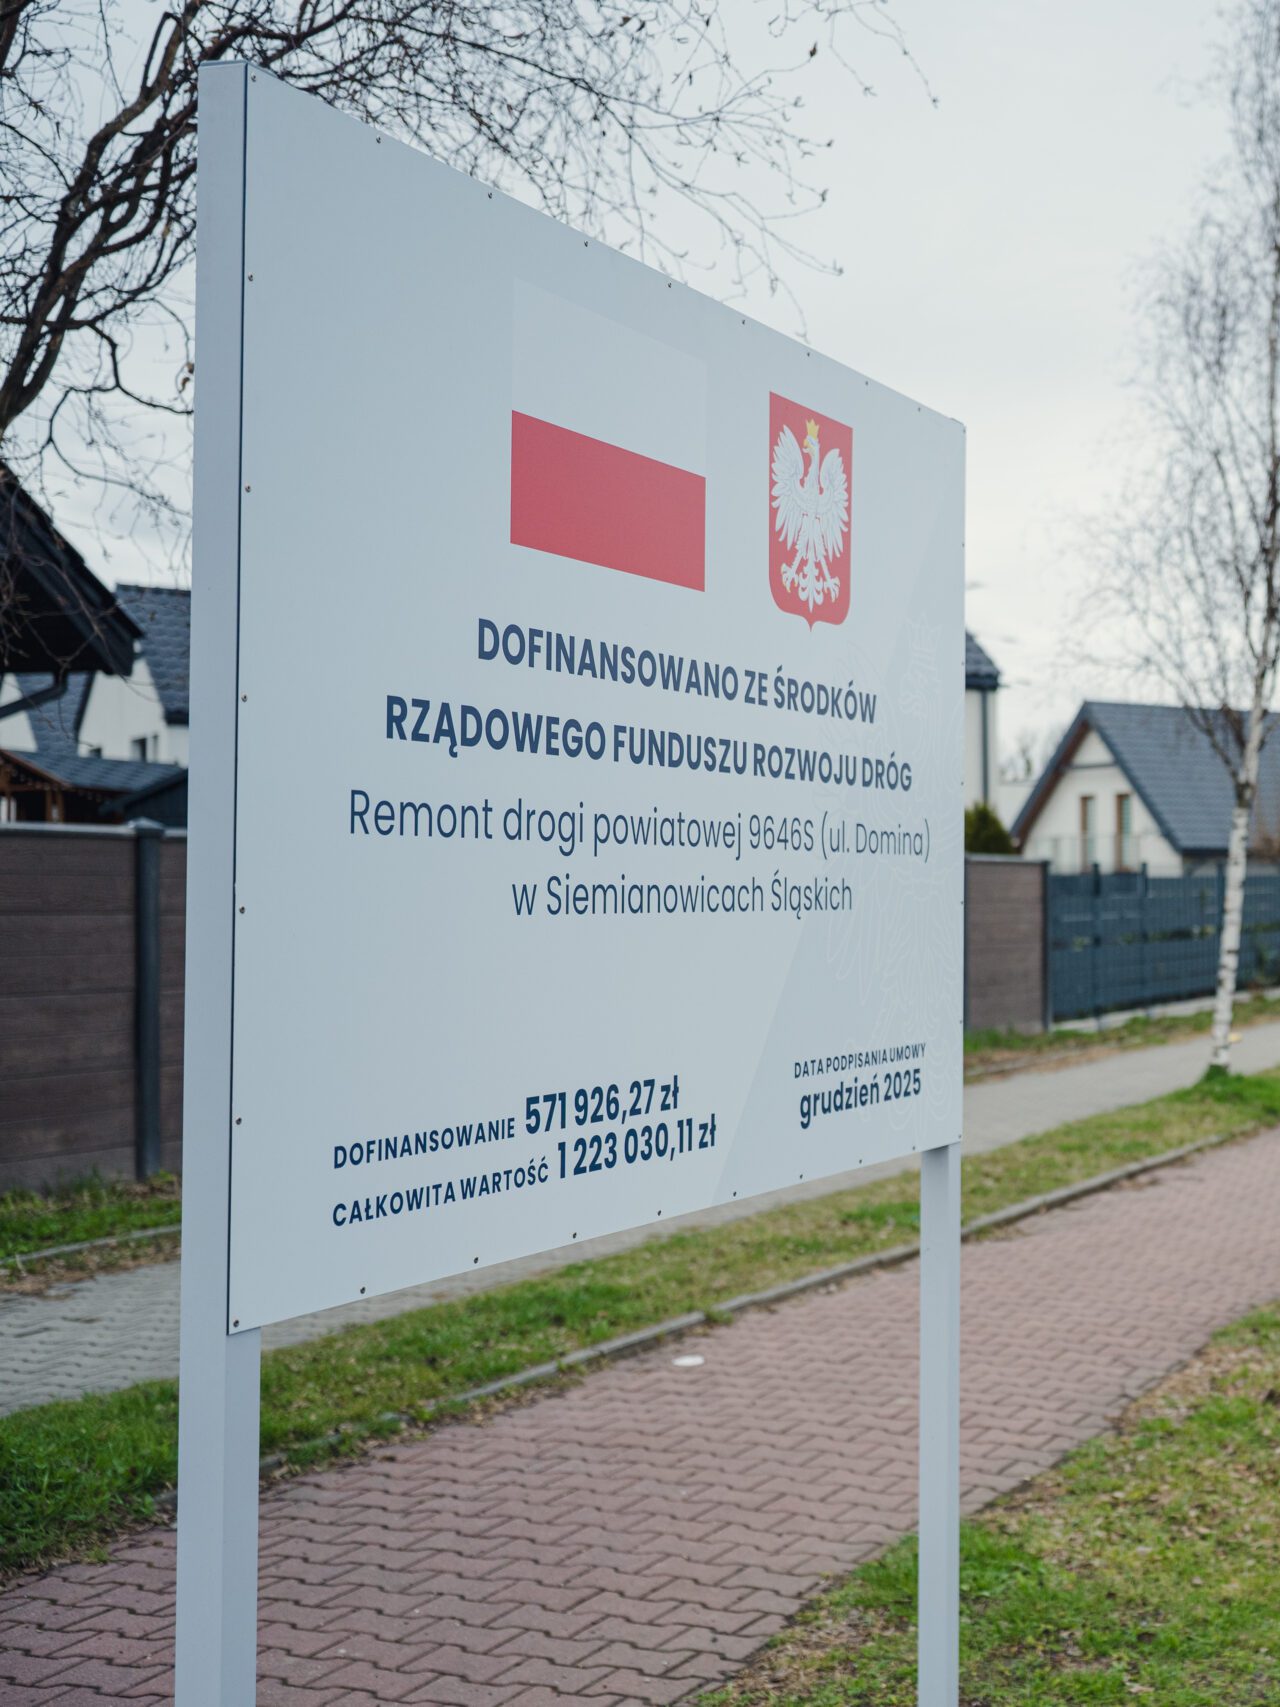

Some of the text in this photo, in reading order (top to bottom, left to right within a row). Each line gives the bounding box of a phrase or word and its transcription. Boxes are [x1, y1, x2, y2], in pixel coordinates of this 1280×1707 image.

[478, 618, 877, 724] DOFINANSOWANO ZE ŚRODKÓW
[386, 695, 912, 792] RZĄDOWEGO FUNDUSZU ROZWOJU DRÓG
[350, 789, 930, 863] Remont drogi powiatowej 9646S (ul. Domina)
[512, 871, 852, 920] w Siemianowicach Śląskich
[795, 1044, 925, 1078] DATA PODPISANIA UMOWY
[800, 1068, 921, 1130] grudzień 2025
[334, 1075, 679, 1169] DOFINANSOWANIE 571 926,27 zł
[333, 1113, 716, 1227] CAŁKOWITA WARTOŚĆ 1 223 030,11 zł
